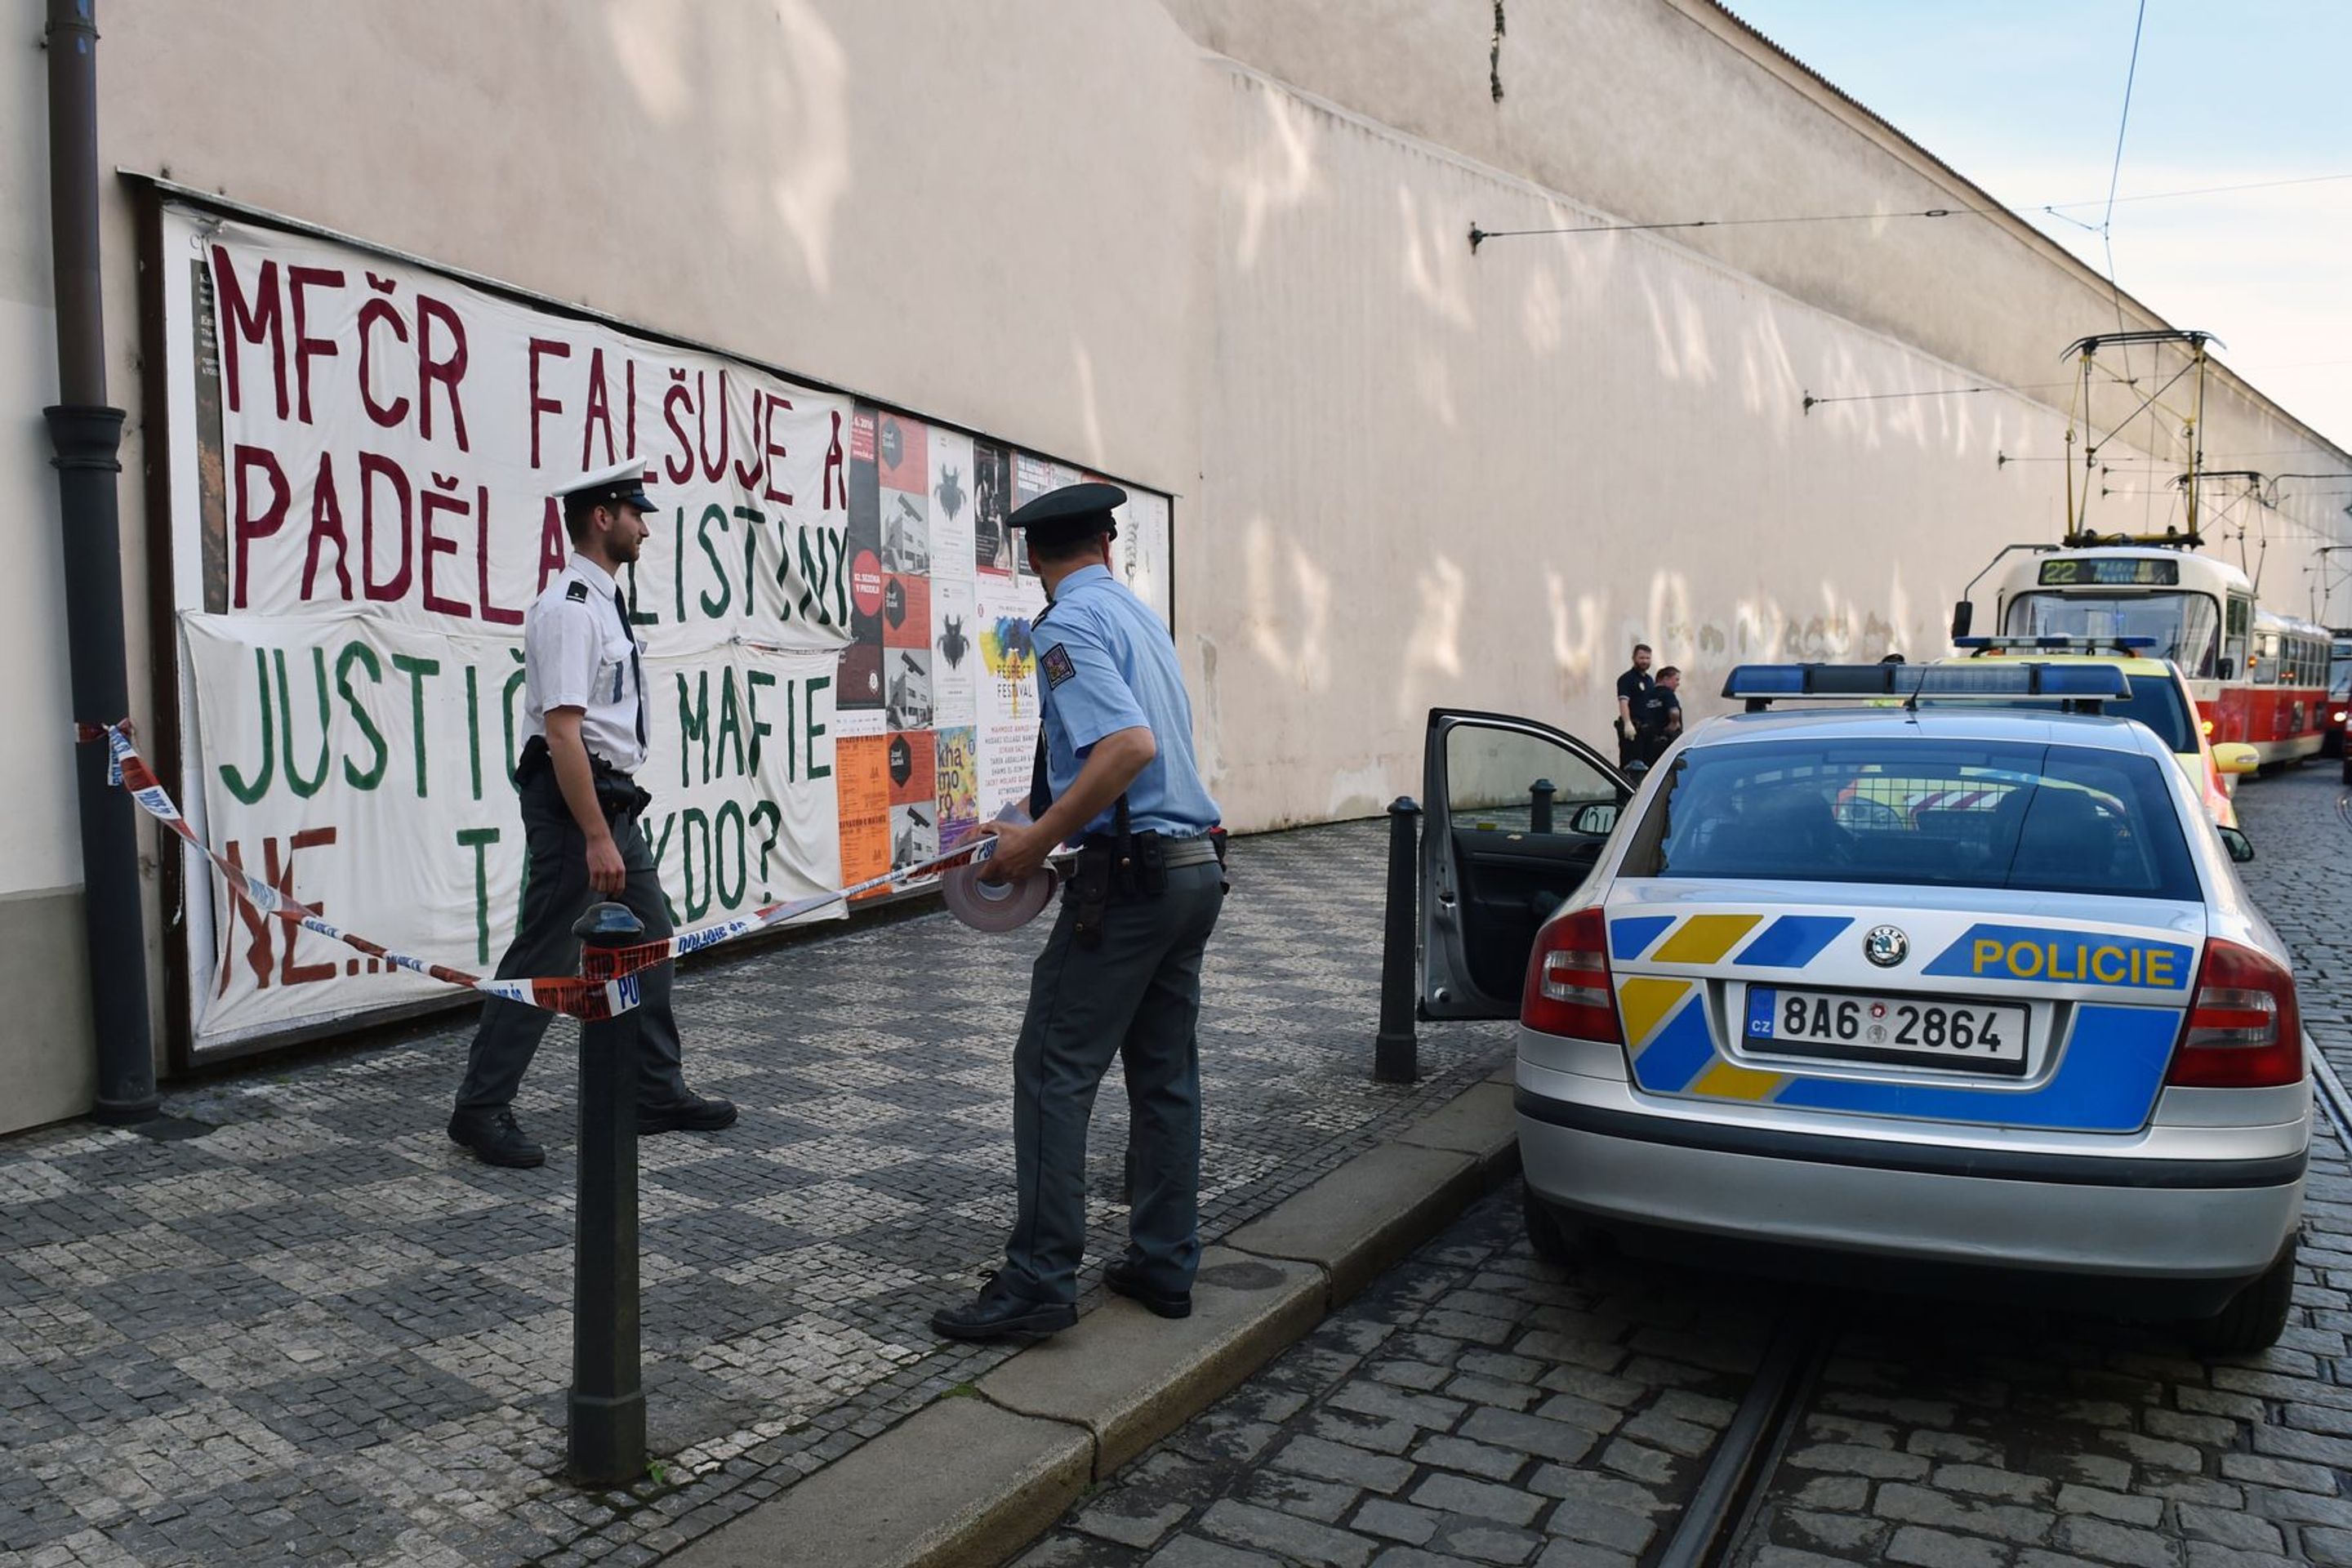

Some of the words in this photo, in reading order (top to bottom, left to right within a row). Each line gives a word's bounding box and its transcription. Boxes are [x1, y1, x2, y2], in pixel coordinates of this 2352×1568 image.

[212, 243, 470, 453] MFČR
[529, 336, 793, 506] FALŠUJE
[823, 410, 847, 511] A
[2043, 561, 2078, 583] 22
[996, 683, 1033, 697] FESTVAL
[675, 665, 831, 788] MAFIE
[1972, 939, 2175, 987] POLICIE
[1751, 1019, 1771, 1033] CZ
[1784, 996, 1861, 1040] 8A6
[1895, 1004, 2001, 1053] 2864
